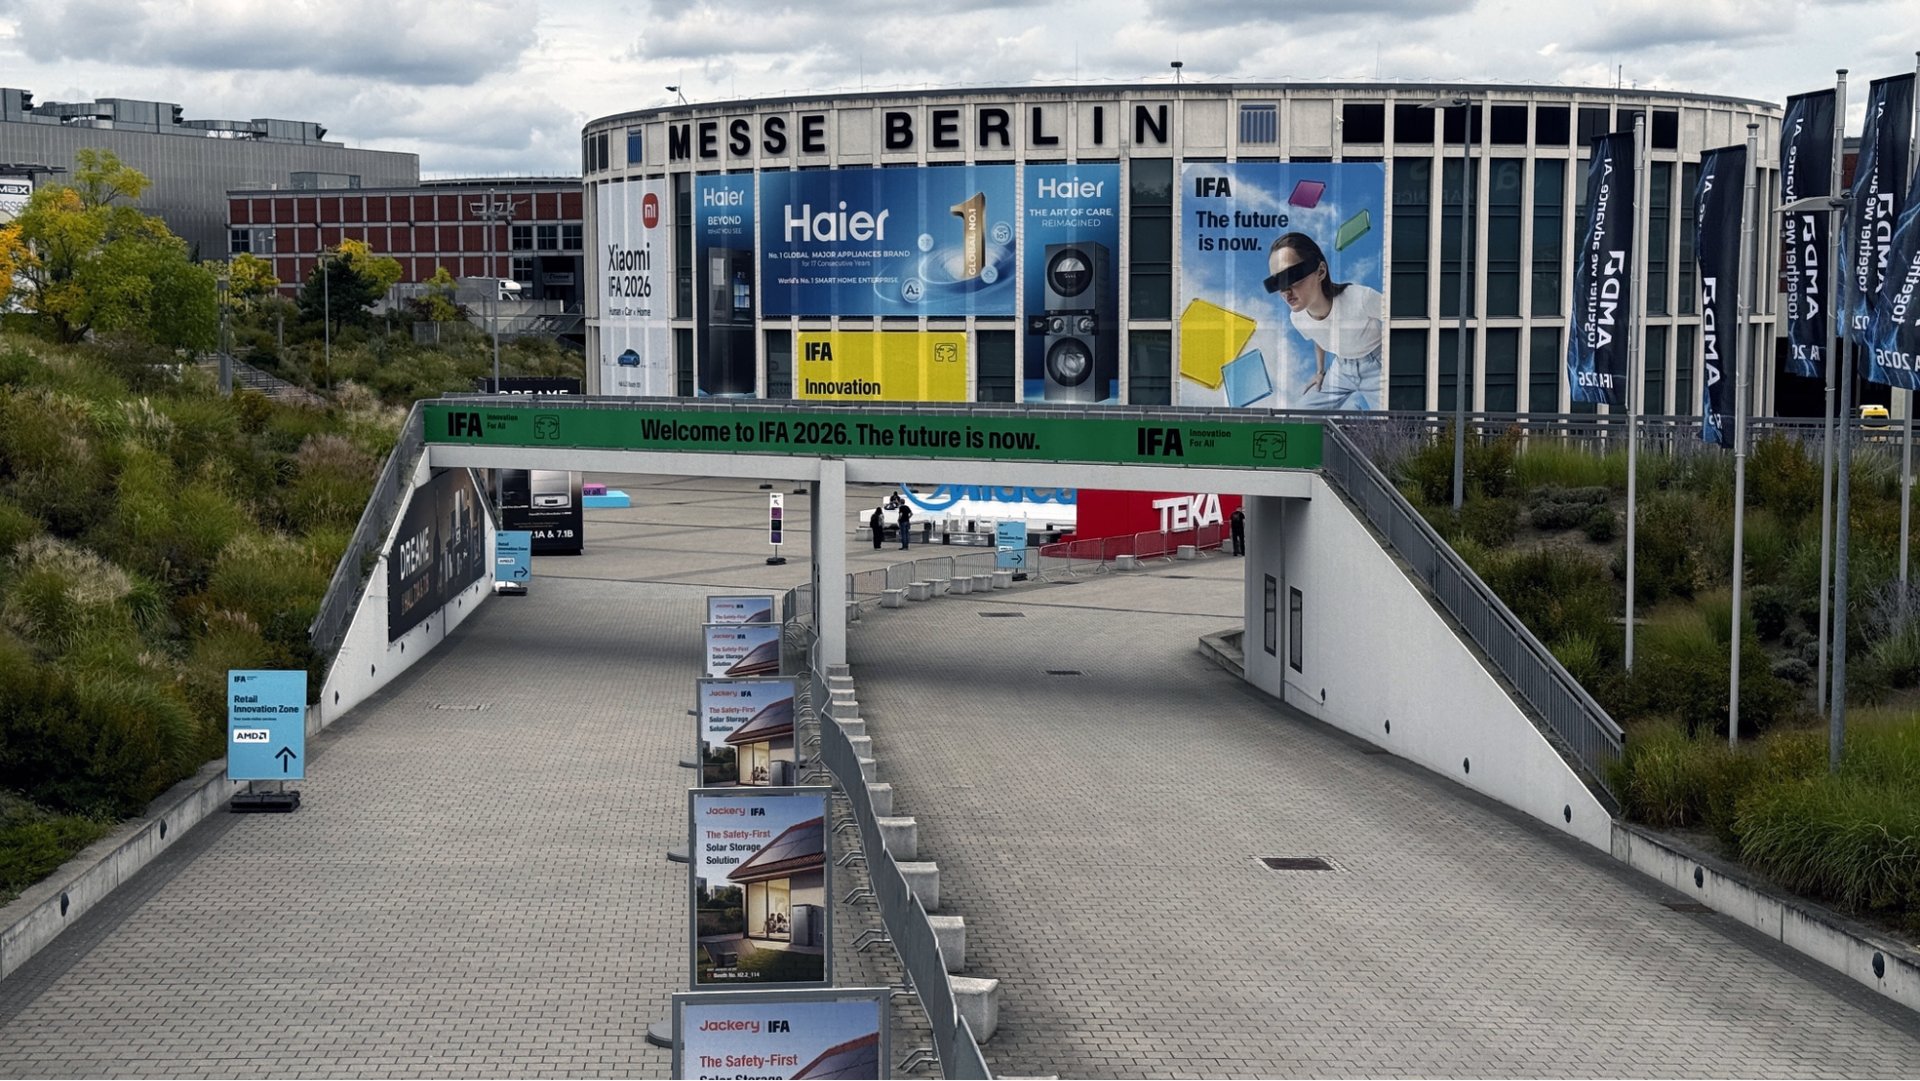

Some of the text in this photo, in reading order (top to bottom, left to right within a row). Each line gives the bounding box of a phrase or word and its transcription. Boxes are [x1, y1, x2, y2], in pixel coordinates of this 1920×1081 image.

[669, 104, 1169, 160] MESSE BERLIN
[1038, 176, 1104, 199] Haier
[1195, 177, 1232, 198] IFA
[703, 186, 744, 207] Haier
[707, 215, 742, 225] BEYOND
[784, 200, 889, 242] Haier
[1029, 209, 1048, 217] THE
[1049, 208, 1068, 217] ART
[1070, 208, 1084, 216] OF
[1195, 210, 1289, 228] The future
[1042, 219, 1101, 227] REIMAGINED
[968, 208, 977, 276] GLOBAL NO.1
[1198, 233, 1262, 251] is now.
[608, 242, 651, 272] Xiaomi
[783, 251, 809, 259] GLOBAL
[812, 250, 837, 258] MAJOR
[837, 250, 882, 258] APPLIANCES
[883, 250, 911, 258] BRAND
[608, 275, 652, 298] IFA 2026
[805, 342, 833, 362] IFA
[805, 378, 881, 396] Innovation
[447, 411, 483, 437] IFA
[486, 413, 518, 421] Innovation
[641, 418, 1041, 450] Welcome to IFA 2026. The future is now.
[1137, 427, 1184, 457] IFA
[1189, 429, 1232, 438] Innovation
[1189, 438, 1215, 448] For All
[1152, 493, 1224, 534] TEKA
[556, 529, 574, 538] 7.1B
[399, 526, 430, 581] DREAME
[233, 694, 258, 703] Retail
[233, 704, 300, 713] Innovation Zone
[236, 732, 258, 740] AMD
[706, 806, 766, 816] Jackery IFA
[706, 829, 772, 840] The Safety-First
[706, 842, 762, 853] Solar Storage
[706, 855, 740, 865] Solution
[699, 1019, 791, 1033] Jackery IFA
[699, 1053, 799, 1069] The Safety-First
